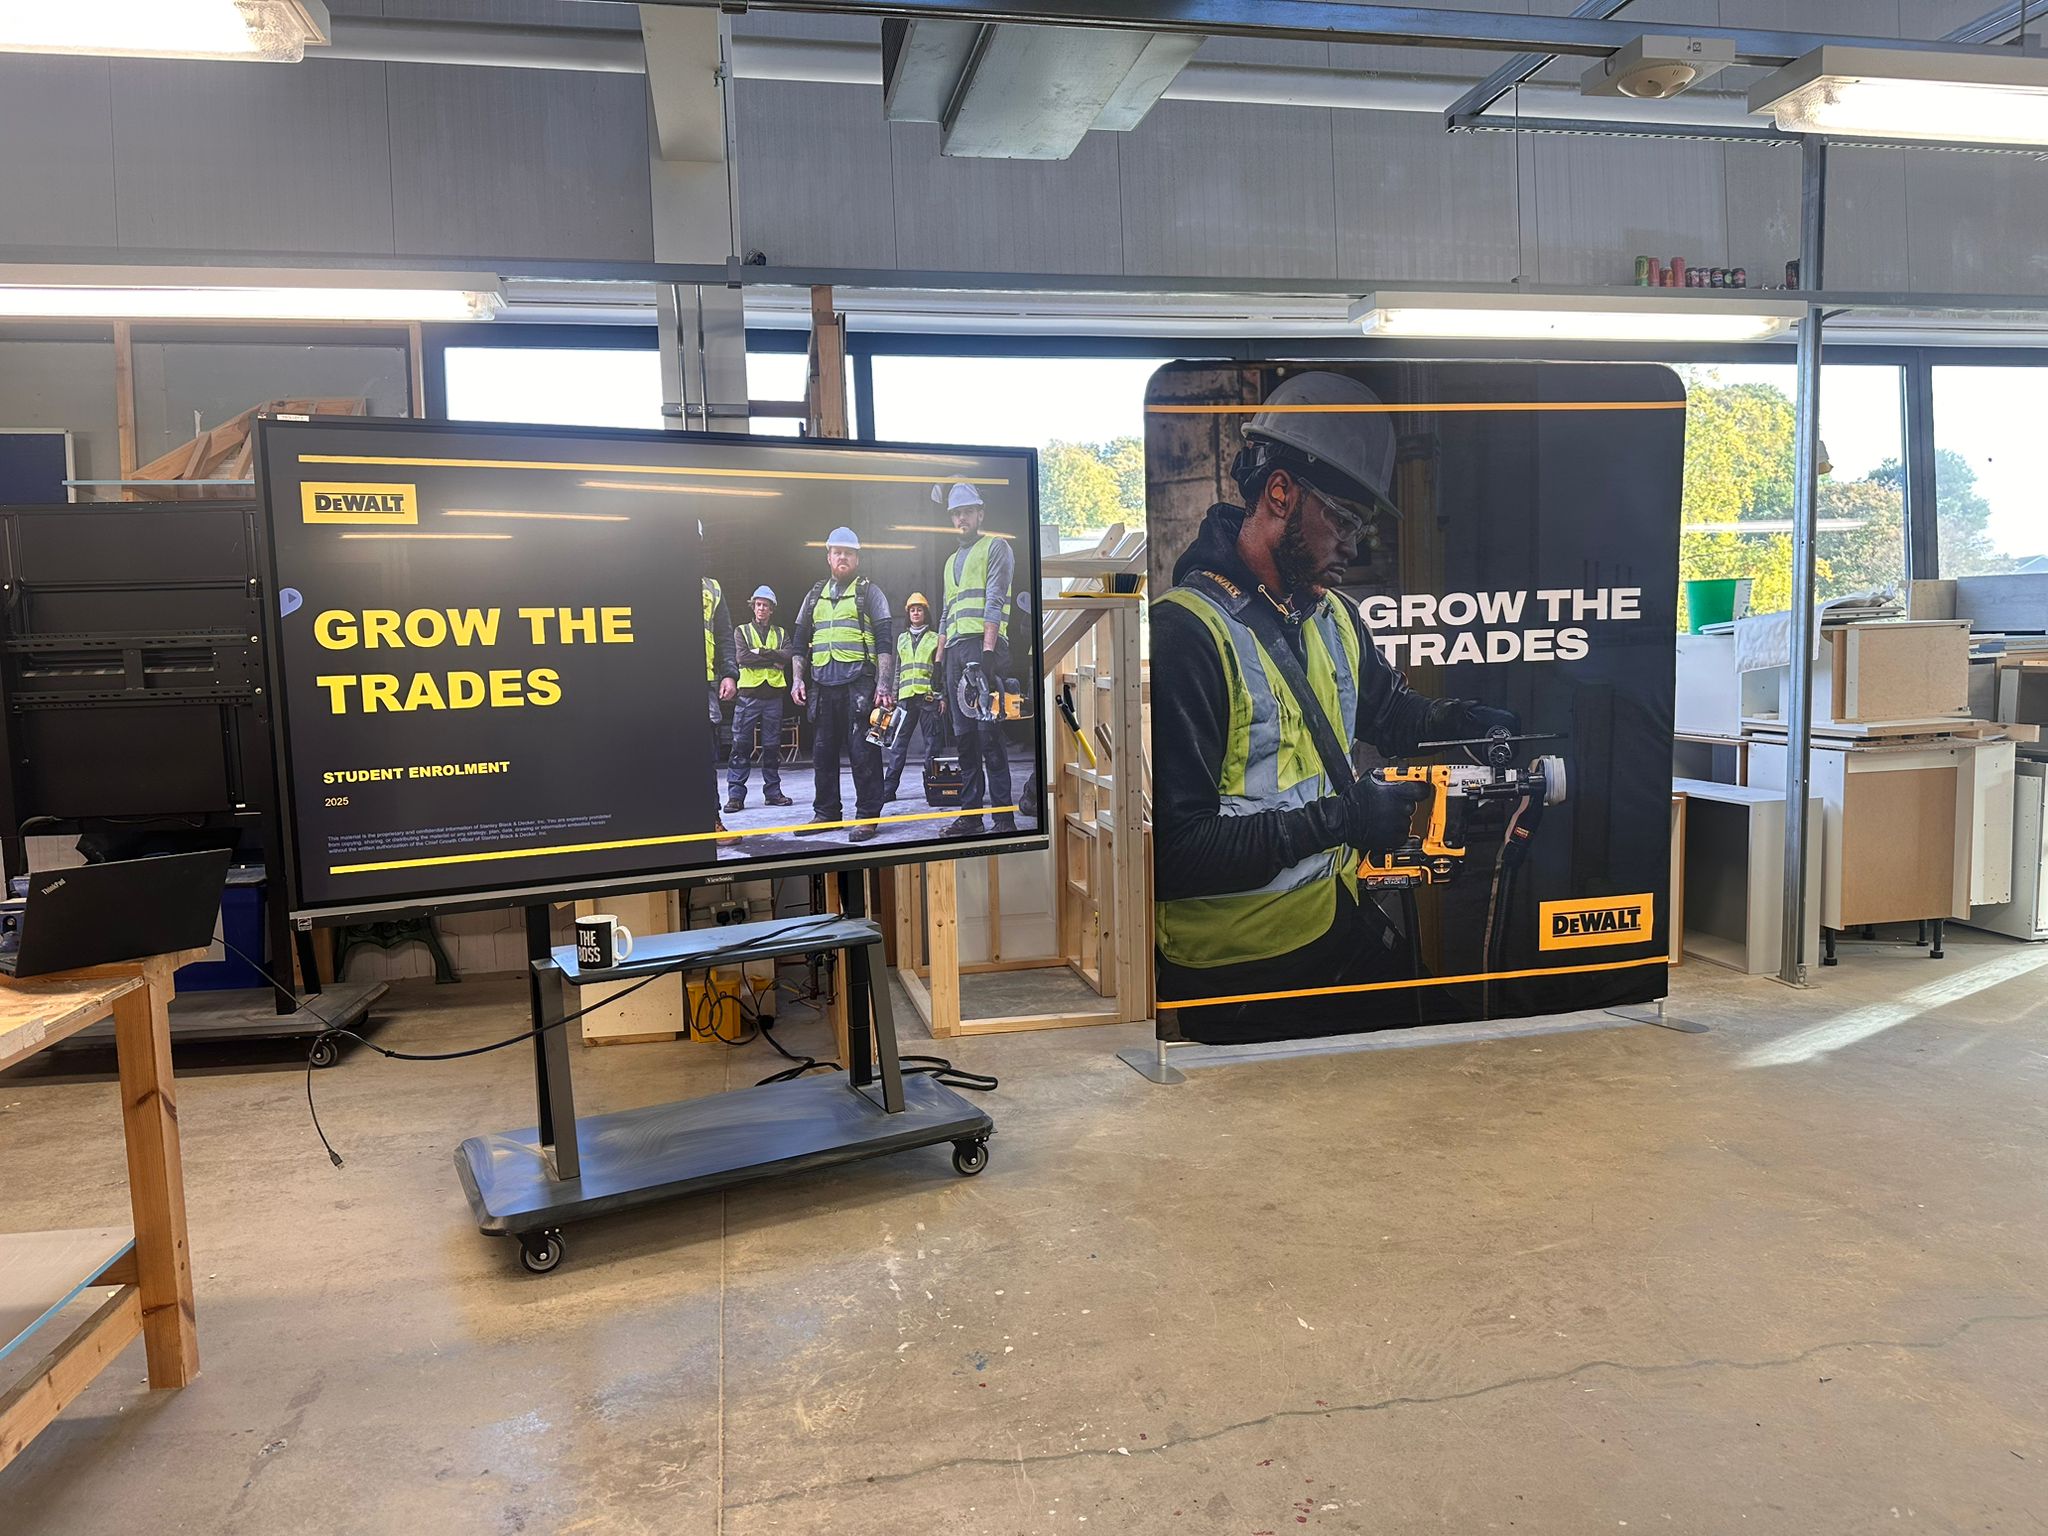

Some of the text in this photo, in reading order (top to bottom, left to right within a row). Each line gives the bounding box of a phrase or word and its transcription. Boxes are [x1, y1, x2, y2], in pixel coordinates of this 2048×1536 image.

[313, 606, 635, 650] GROW THE
[1359, 587, 1641, 629] GROW THE
[1372, 627, 1589, 667] TRADES
[315, 668, 563, 715] TRADES
[323, 761, 511, 784] STUDENT ENROLMENT
[324, 797, 350, 807] 2025
[579, 930, 596, 946] THE
